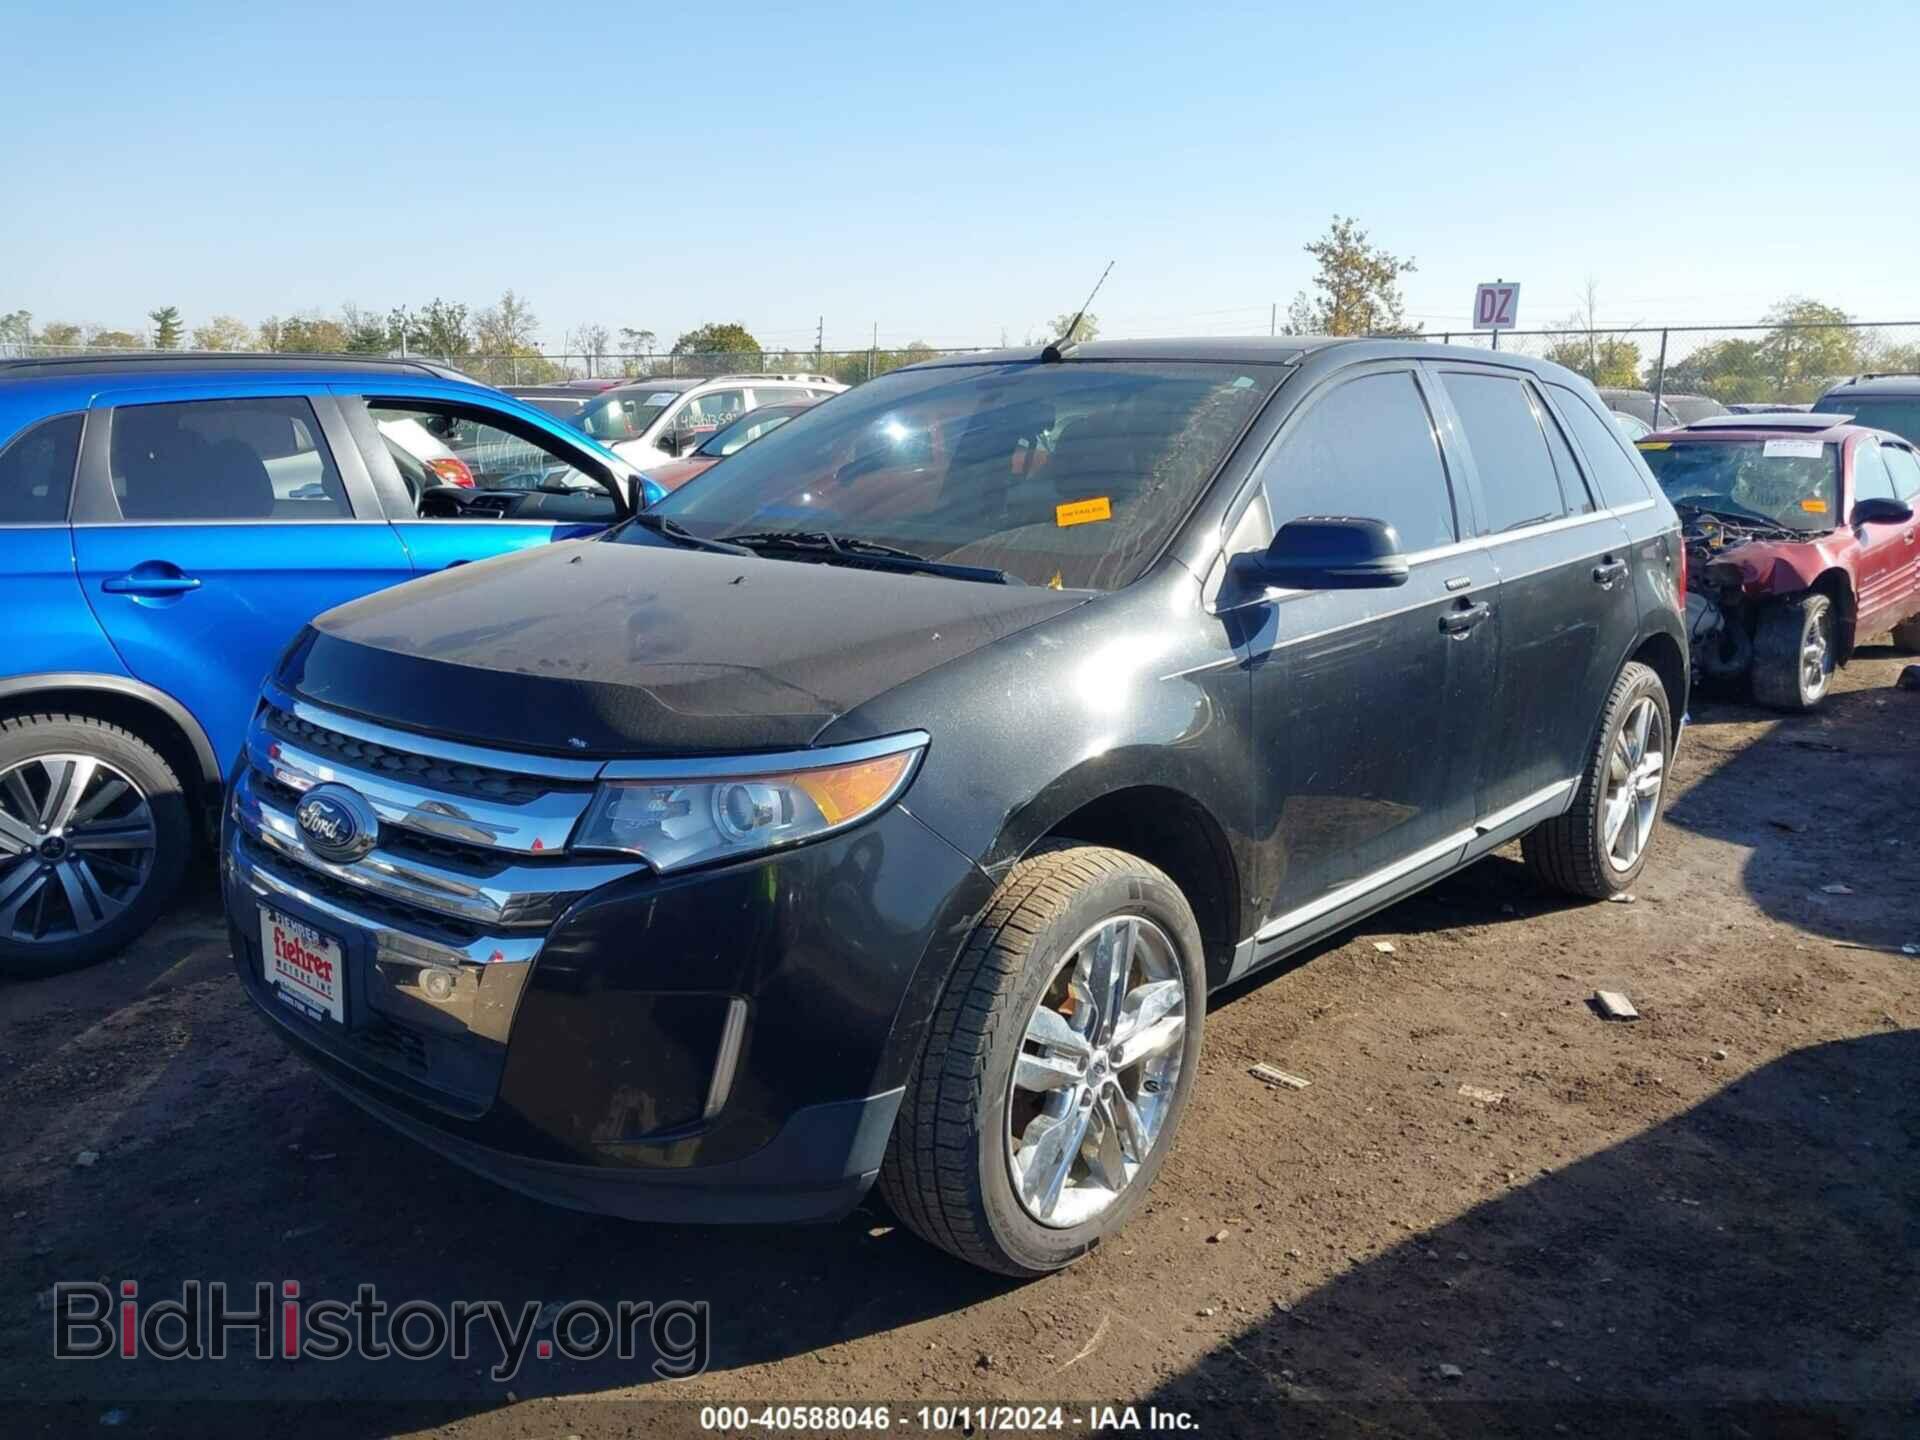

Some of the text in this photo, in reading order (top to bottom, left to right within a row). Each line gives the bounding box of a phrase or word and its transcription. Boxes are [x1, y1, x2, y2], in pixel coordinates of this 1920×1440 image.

[1480, 288, 1513, 323] DZ
[300, 800, 341, 839] Ford
[274, 926, 332, 982] fiehrer
